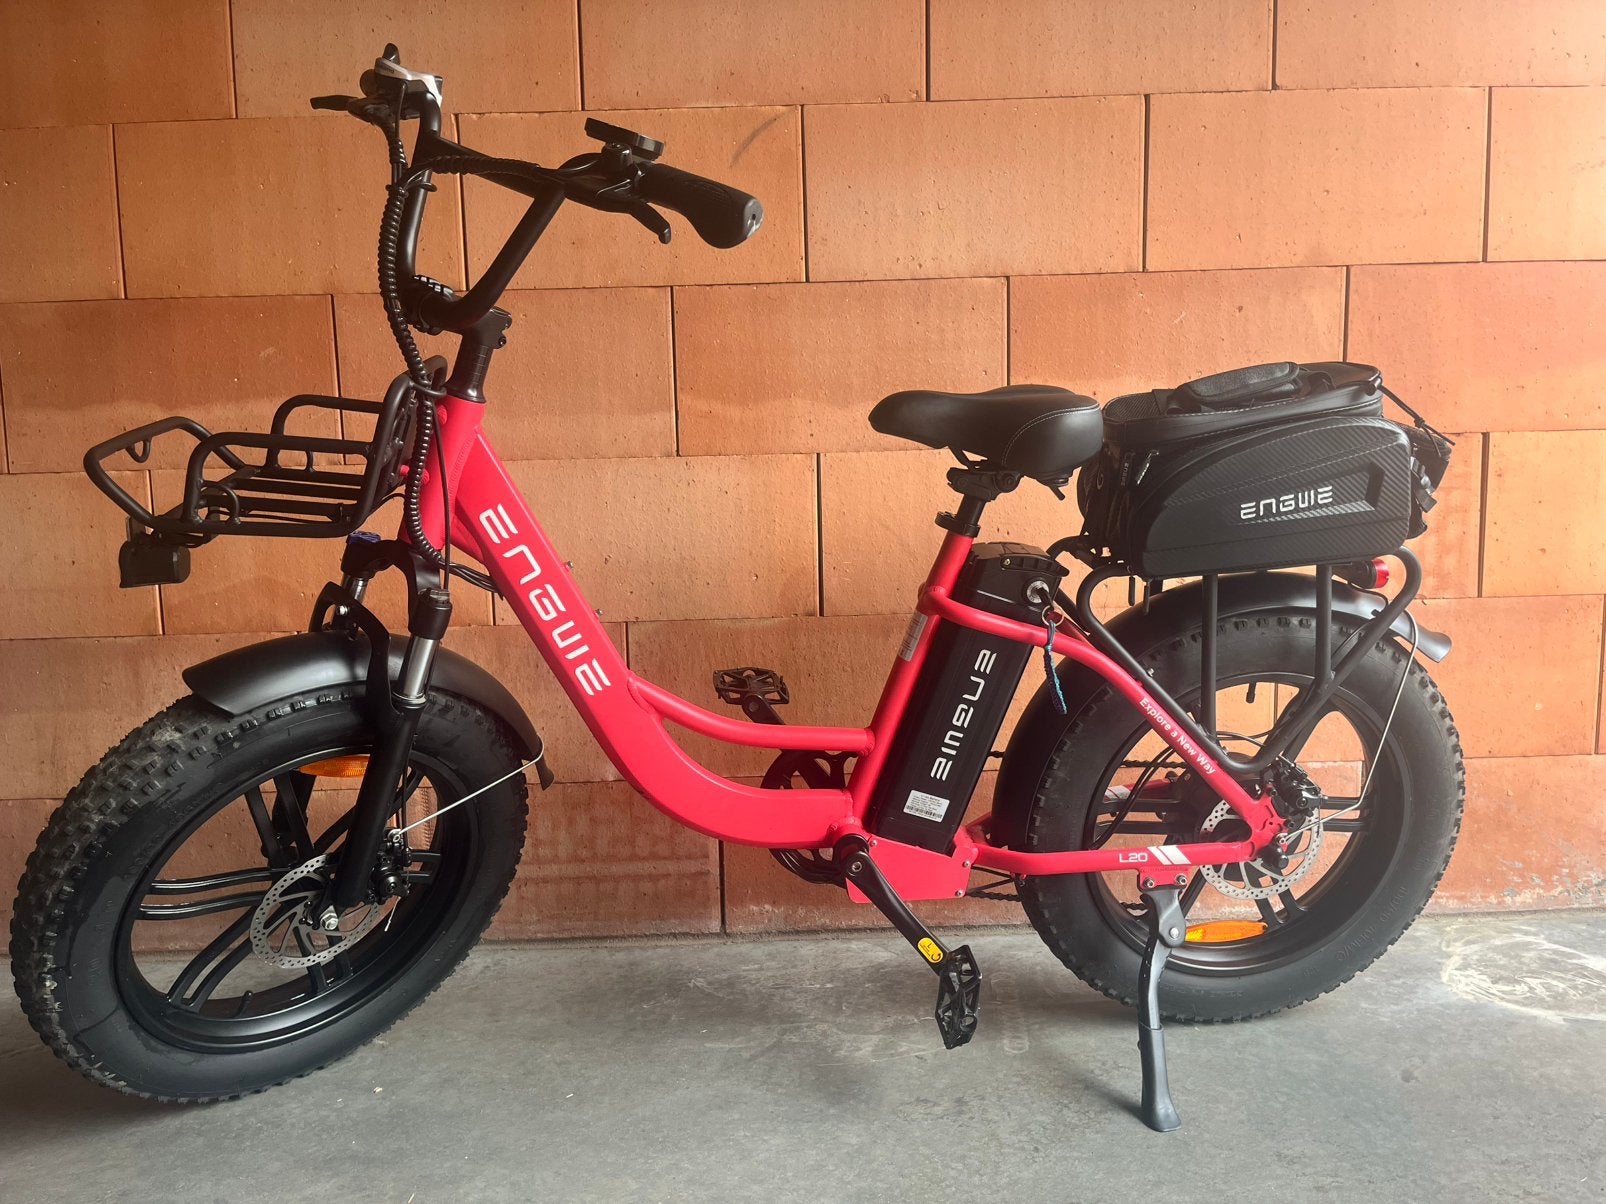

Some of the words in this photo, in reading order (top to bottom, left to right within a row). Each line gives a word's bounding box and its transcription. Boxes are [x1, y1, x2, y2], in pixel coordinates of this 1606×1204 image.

[1140, 697, 1171, 730] Explore
[1170, 730, 1178, 738] a
[1177, 735, 1197, 756] New
[1196, 753, 1216, 774] Way
[1119, 852, 1148, 863] L20
